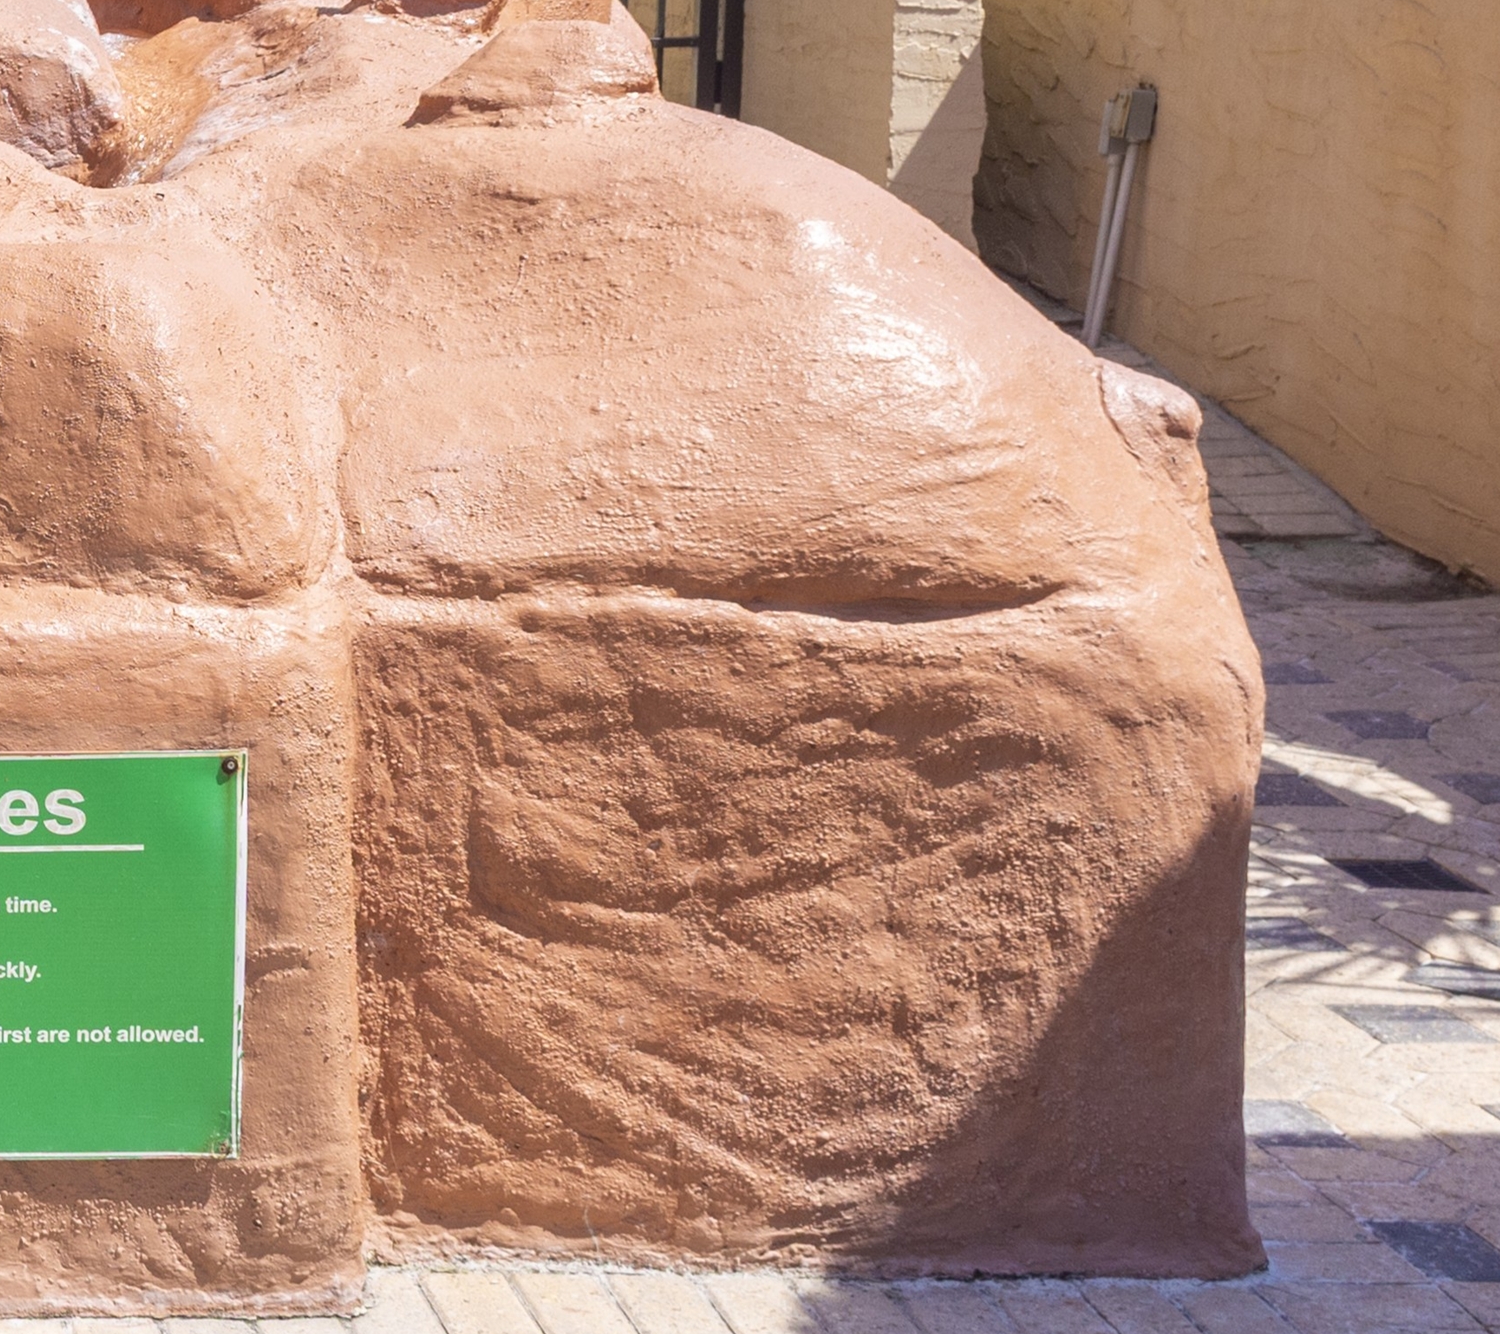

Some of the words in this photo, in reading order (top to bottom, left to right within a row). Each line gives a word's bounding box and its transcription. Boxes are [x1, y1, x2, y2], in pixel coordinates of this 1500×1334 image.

[5, 896, 58, 914] time.
[36, 1029, 71, 1043] are
[76, 1025, 112, 1043] not
[115, 1025, 205, 1043] allowed.
